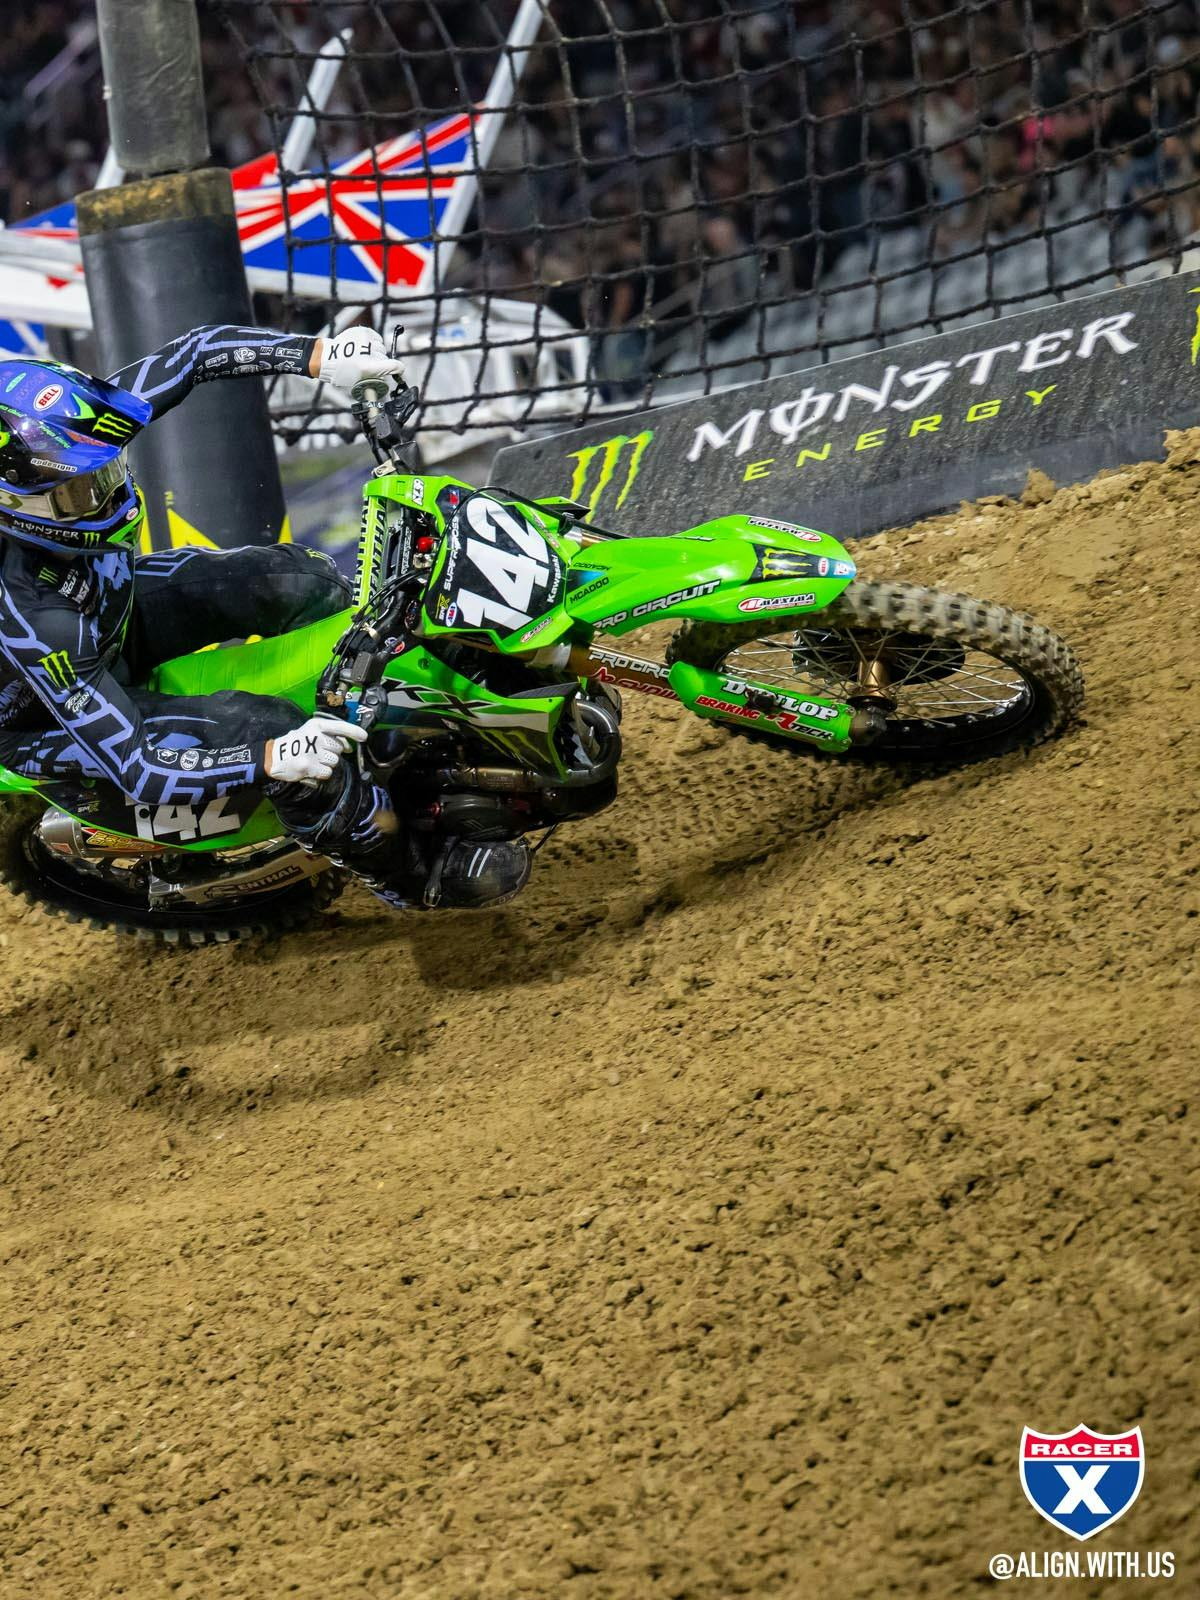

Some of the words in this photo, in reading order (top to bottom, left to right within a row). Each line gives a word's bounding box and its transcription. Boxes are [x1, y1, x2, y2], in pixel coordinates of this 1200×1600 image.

[328, 341, 373, 361] FOX
[39, 388, 59, 407] BELL
[686, 310, 1138, 462] MONSTER
[742, 384, 1058, 482] ENERGY
[13, 519, 79, 539] MONSTER
[456, 497, 549, 631] 142
[547, 554, 559, 603] Kawasaki
[569, 577, 610, 604] MCADOO
[592, 611, 627, 628] PRO
[631, 579, 722, 617] CIRCUIT
[589, 650, 627, 668] PRO
[696, 695, 762, 721] BRAKING
[279, 736, 318, 761] FOX
